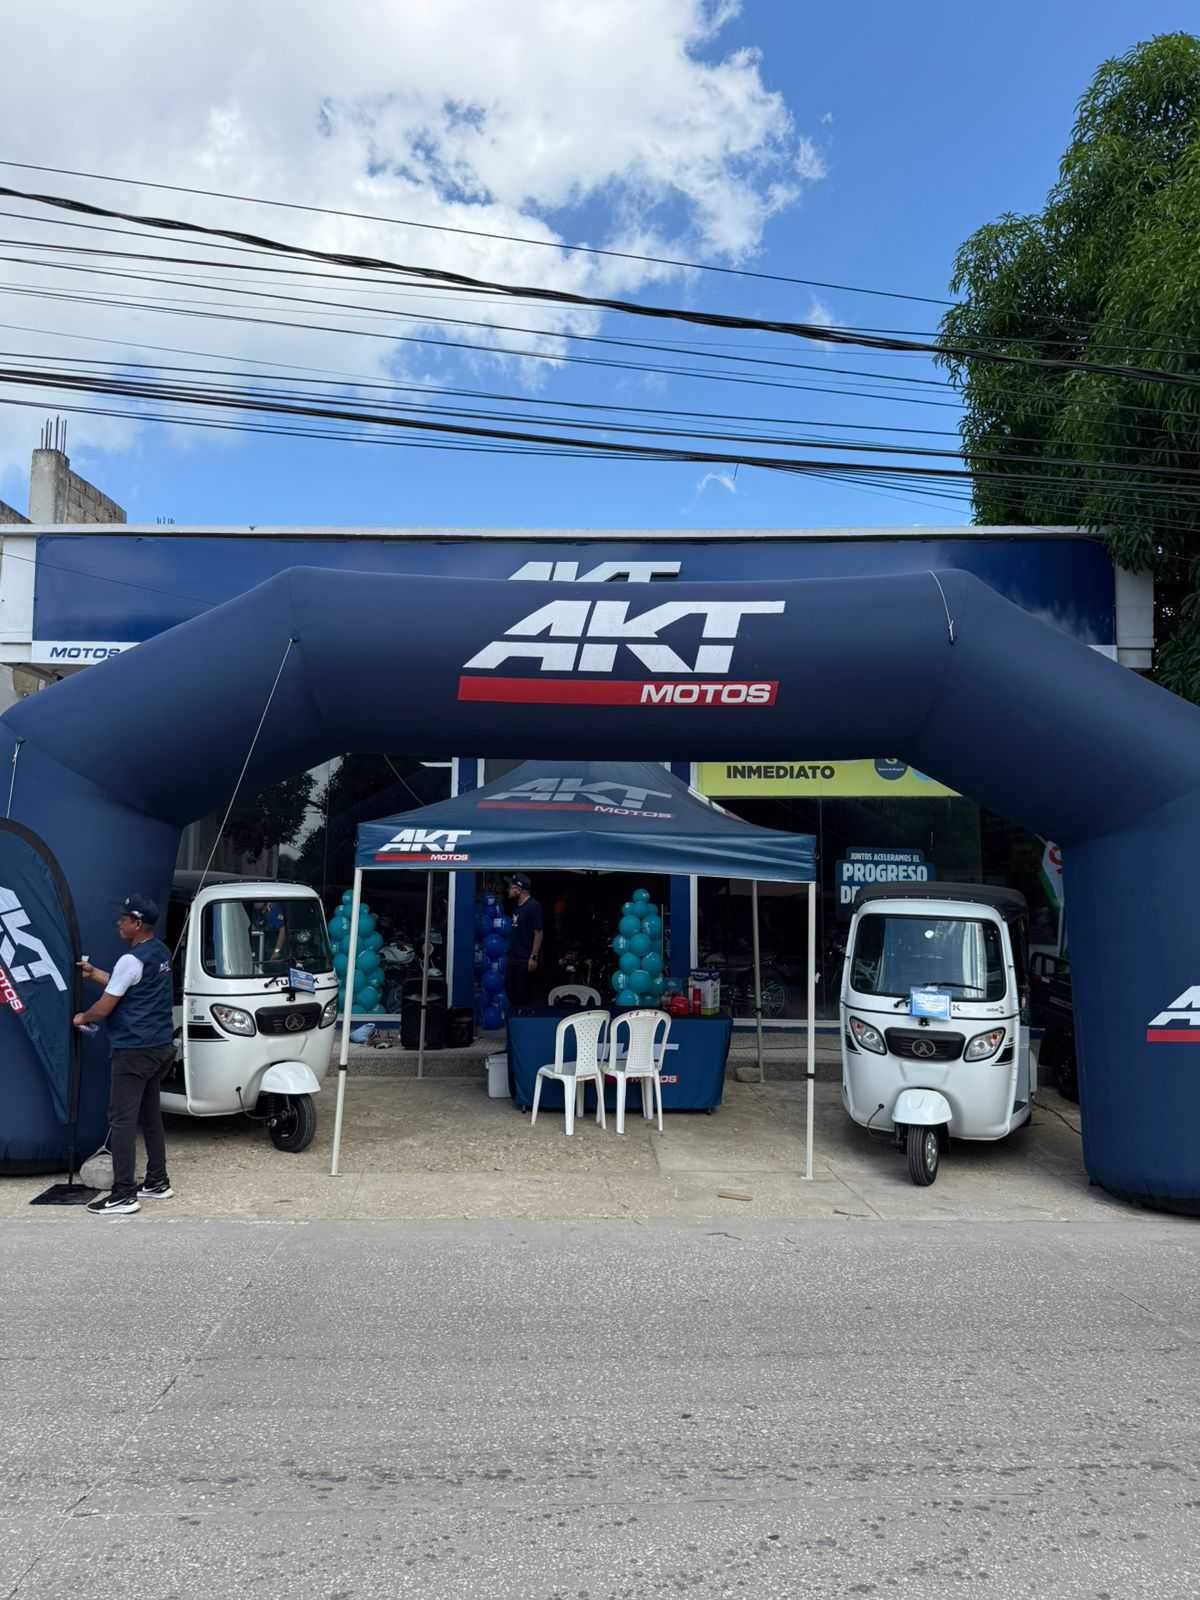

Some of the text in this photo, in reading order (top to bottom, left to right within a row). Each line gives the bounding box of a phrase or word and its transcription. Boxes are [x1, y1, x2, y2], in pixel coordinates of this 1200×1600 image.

[462, 600, 785, 673] AKT
[640, 684, 771, 704] MOTOS
[726, 765, 835, 779] INMEDIATO
[484, 777, 673, 809] AKT
[594, 805, 673, 819] MOTOS
[378, 829, 472, 852] AKT
[873, 853, 912, 862] ACELERAMOS
[842, 863, 928, 882] PROGRESO
